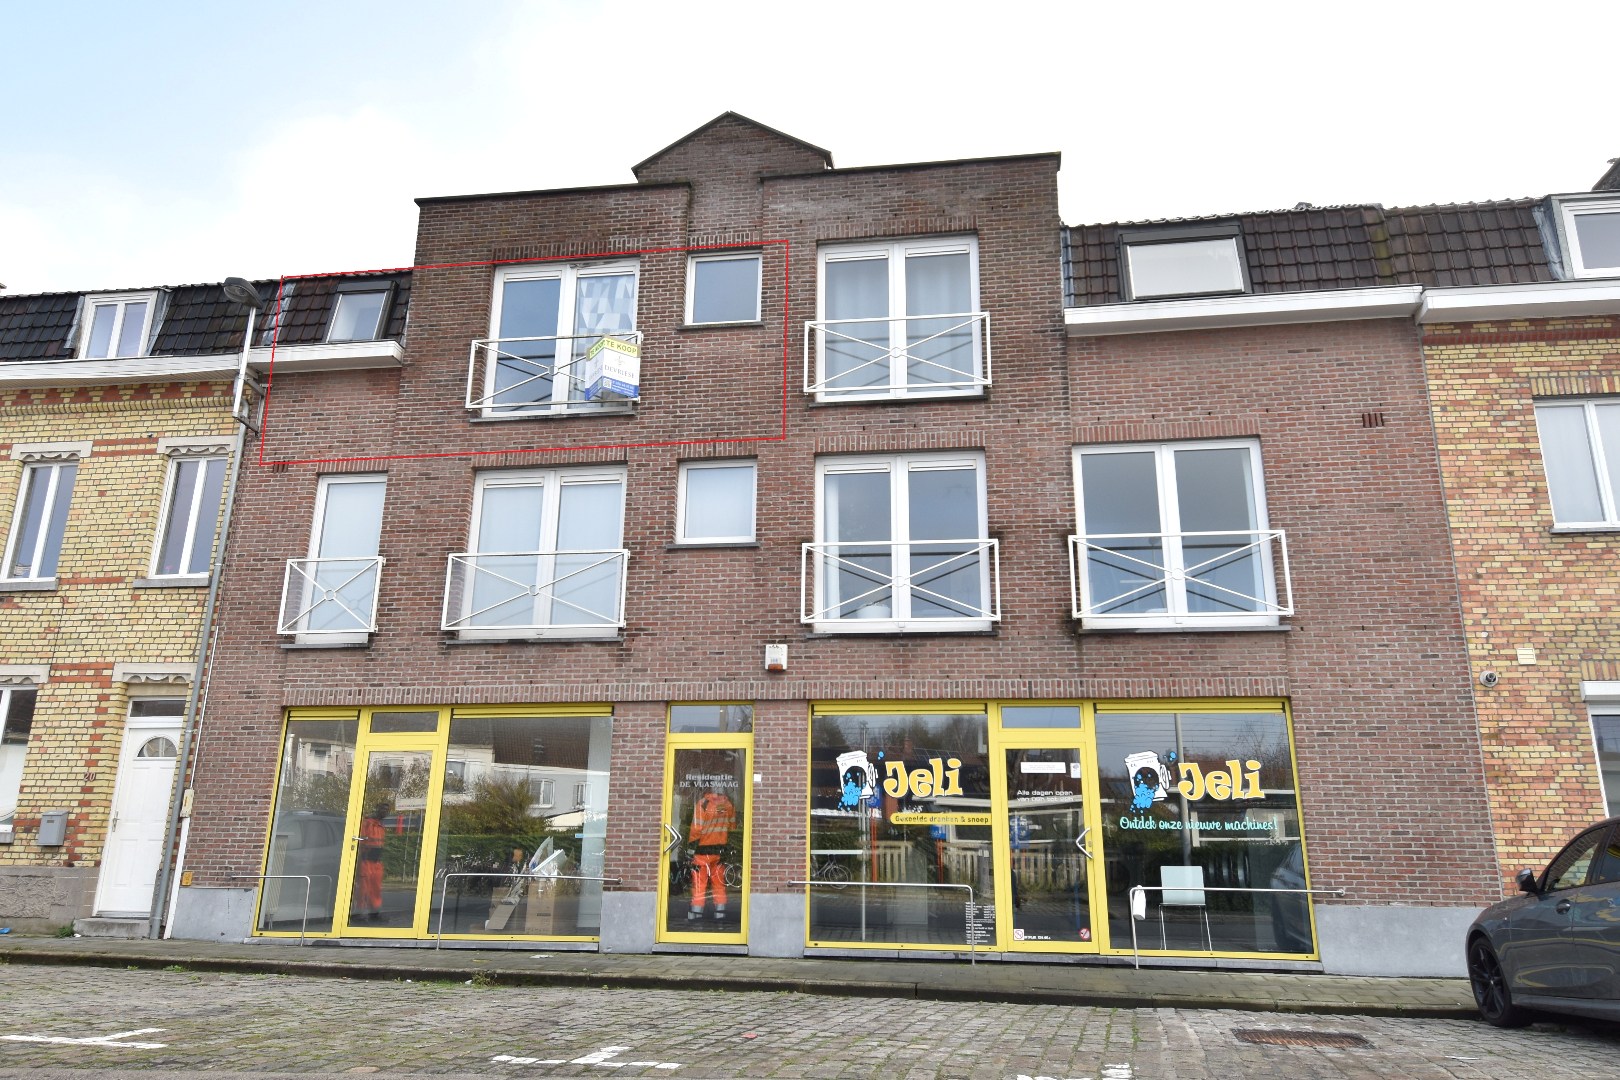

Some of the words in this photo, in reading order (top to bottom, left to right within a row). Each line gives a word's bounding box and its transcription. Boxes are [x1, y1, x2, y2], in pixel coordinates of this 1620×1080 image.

[605, 340, 615, 348] TE
[616, 343, 637, 354] KOOP
[685, 773, 733, 781] Residentie
[883, 758, 963, 798] Jeli
[1177, 760, 1266, 800] Jeli
[1031, 789, 1054, 797] dagen
[967, 816, 989, 824] snoep
[1119, 816, 1156, 830] Ontdek
[1158, 820, 1183, 830] onze
[1185, 818, 1223, 830] nieuwe
[1224, 816, 1278, 830] machines!
